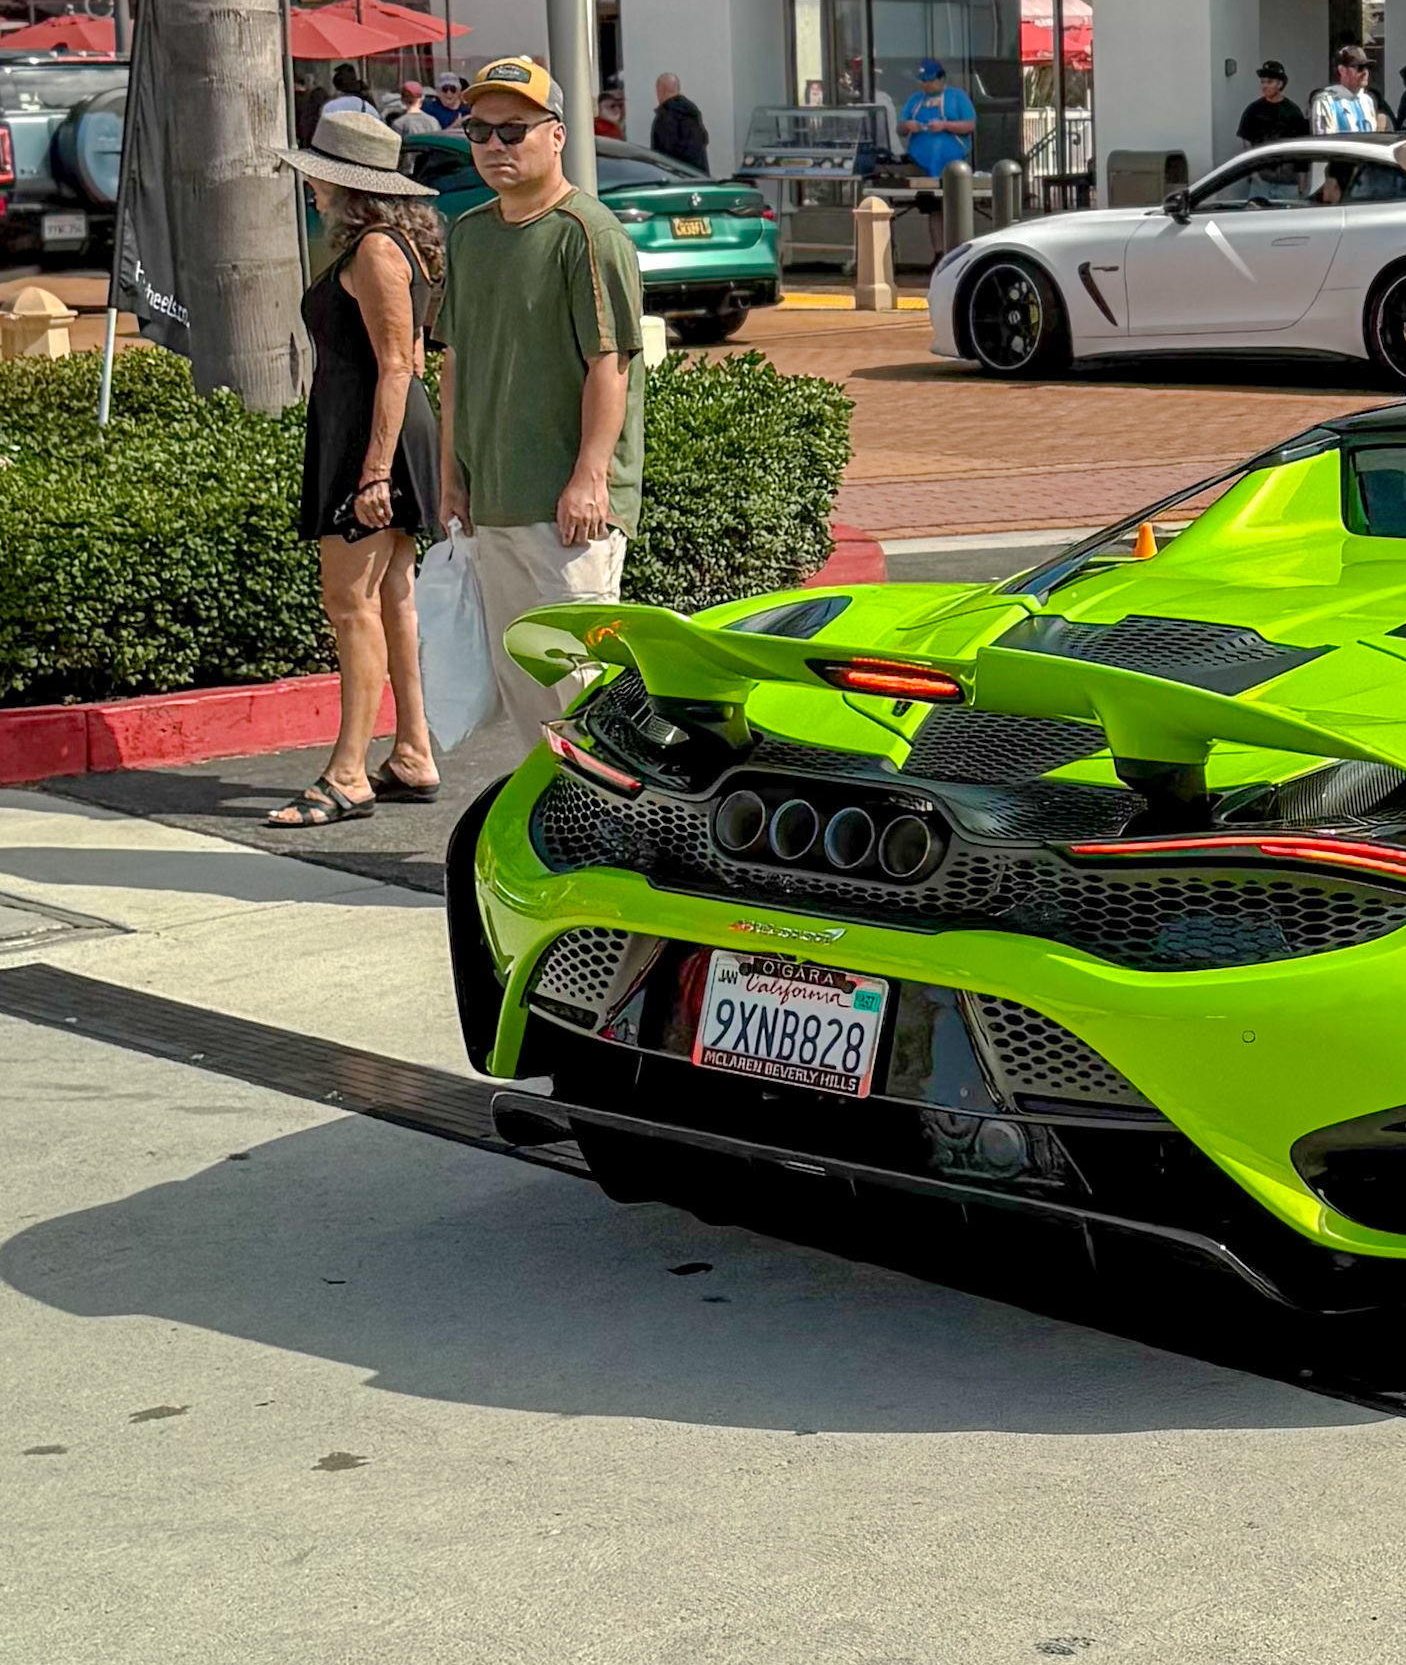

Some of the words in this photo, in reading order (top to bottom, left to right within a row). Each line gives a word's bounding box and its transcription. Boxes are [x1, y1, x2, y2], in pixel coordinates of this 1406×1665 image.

[718, 968, 739, 985] JAN
[745, 972, 851, 1009] California
[762, 959, 835, 985] O'GARA
[711, 998, 865, 1074] 9XNB828
[703, 1049, 763, 1074] MCLAREN
[764, 1061, 819, 1086] BEVERLY
[820, 1072, 857, 1092] HILLS
